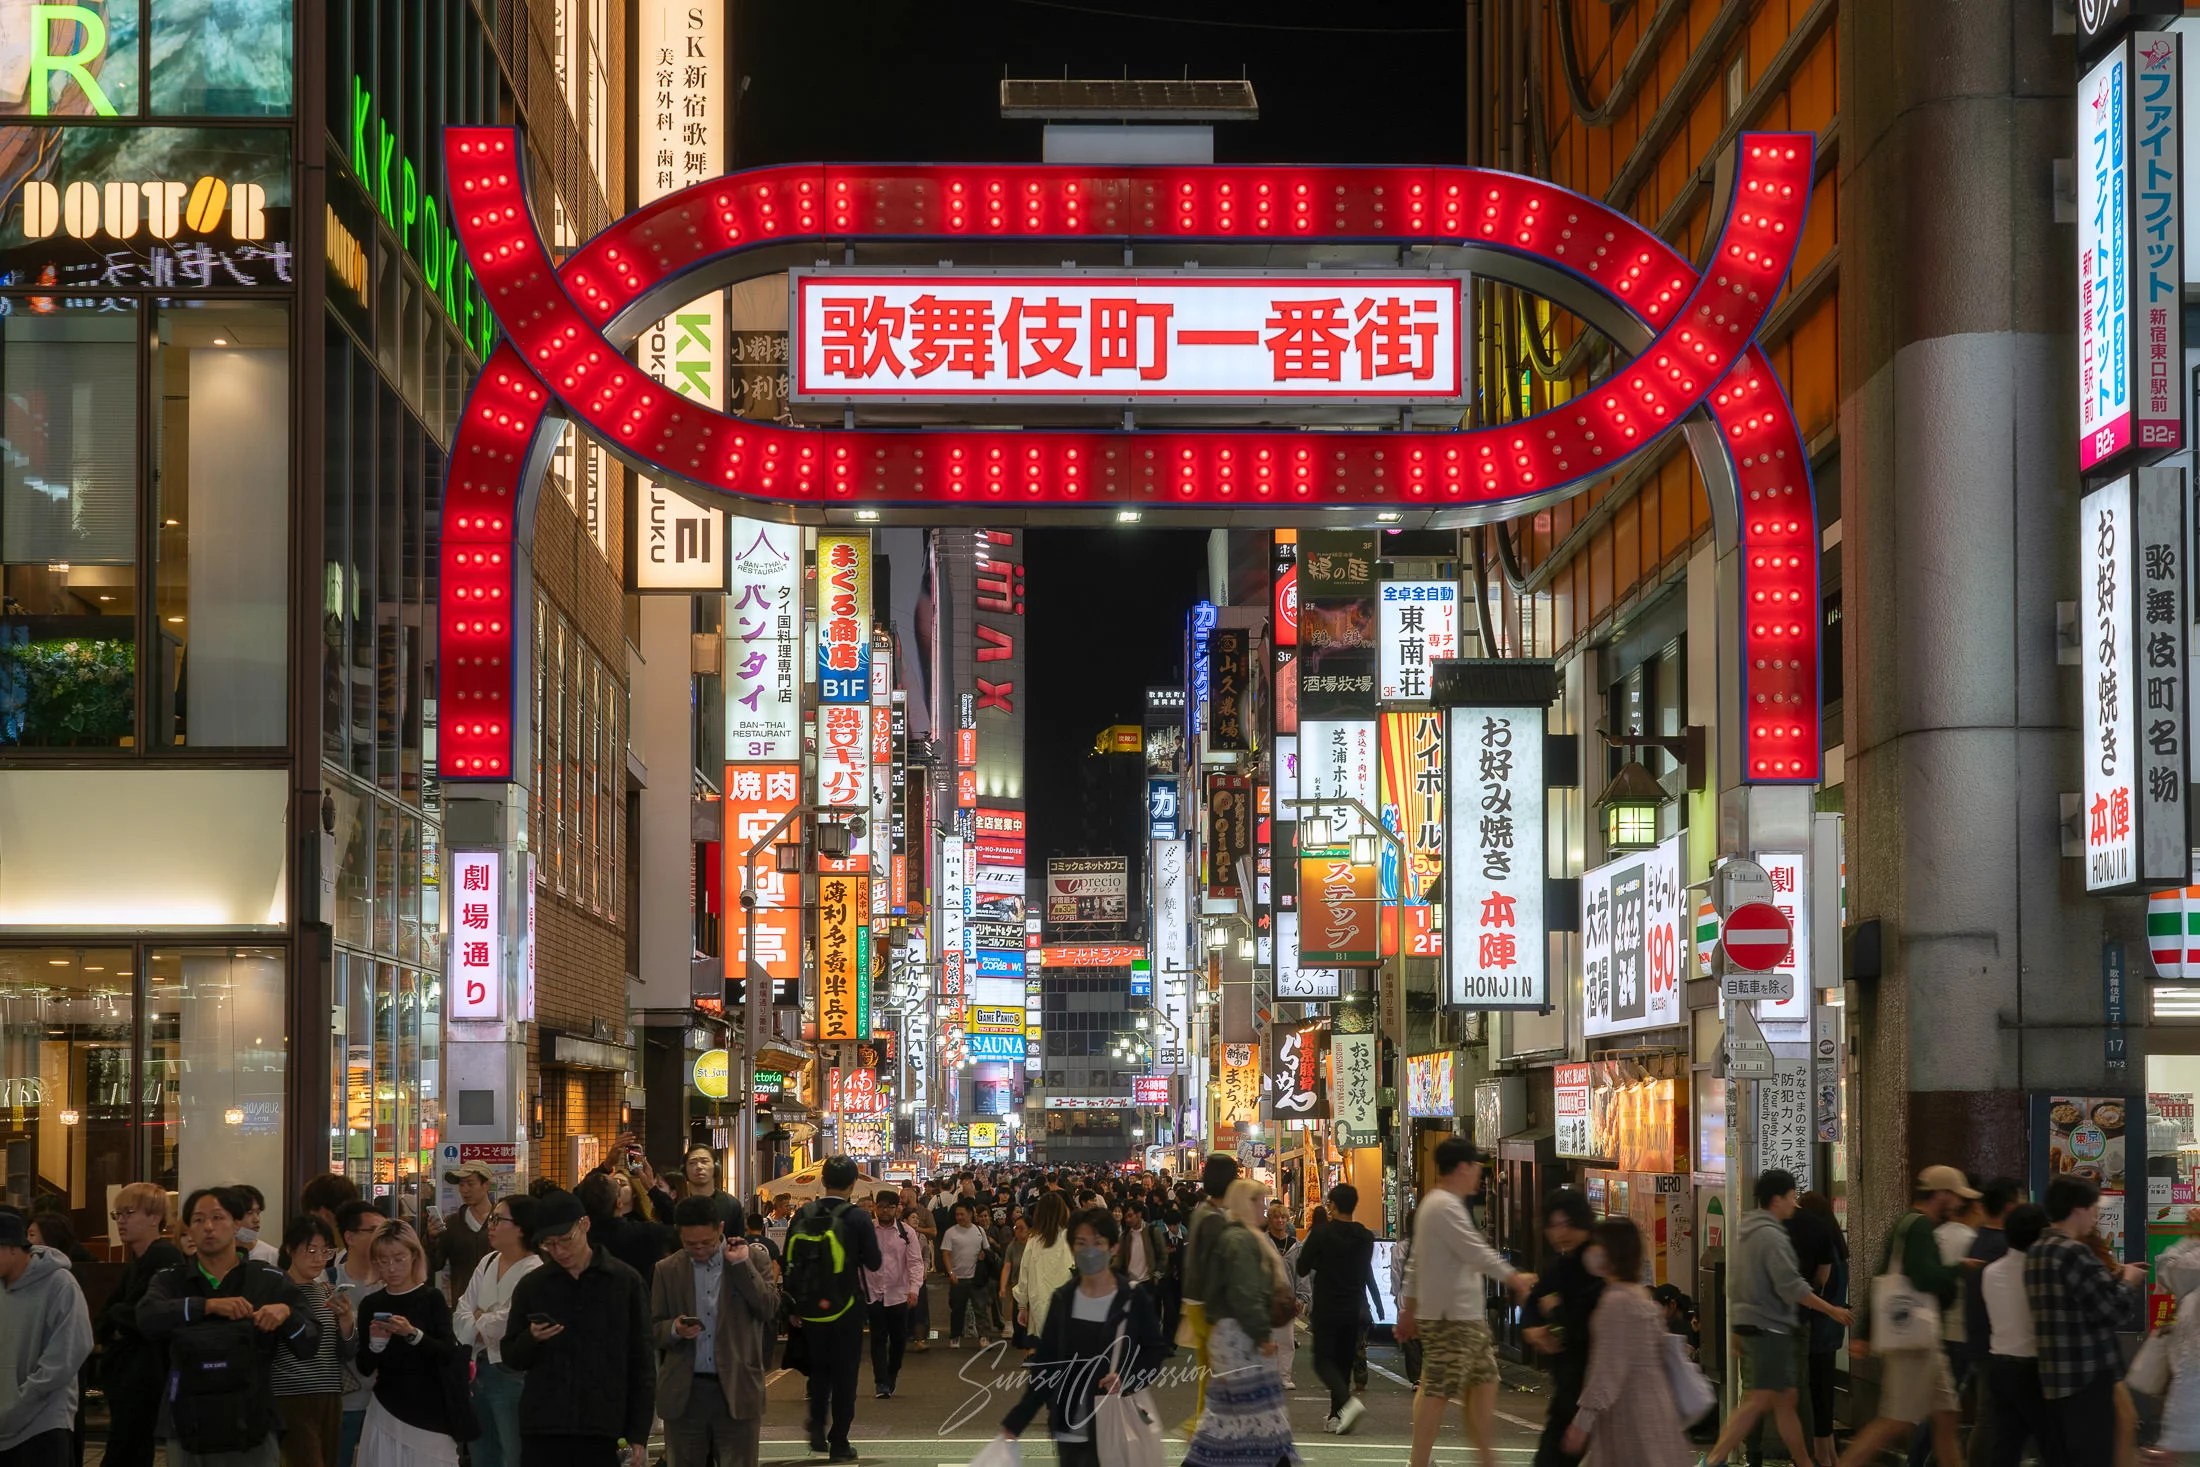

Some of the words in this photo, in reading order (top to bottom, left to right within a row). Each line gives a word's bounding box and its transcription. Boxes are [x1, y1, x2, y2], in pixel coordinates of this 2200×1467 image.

[682, 8, 707, 186] SK新宿歌舞
[656, 47, 674, 189] 美容外科・歯科
[2112, 67, 2122, 156] ボクシング
[2140, 73, 2175, 303] ファイトフィット
[23, 176, 266, 240] DOUTOR
[2113, 176, 2124, 308] キックボクシング
[2093, 127, 2110, 418] ファイトフィット
[822, 294, 1438, 381] 歌舞伎町一番街
[2082, 251, 2095, 425] 新宿東口駅前
[2113, 320, 2124, 402] ダイエット
[2148, 308, 2168, 413] 新宿東口駅前
[2095, 422, 2116, 459] B2F
[2143, 423, 2176, 444] B2F
[737, 563, 788, 576] RESTAURANT
[743, 560, 782, 569] BAN-THAI
[1277, 564, 1289, 573] 4F
[828, 543, 859, 671] まぐろ商店
[1383, 587, 1454, 602] 全卓全自動
[735, 584, 771, 712] バンタイ
[777, 585, 792, 703] タイ国料理専門店
[1277, 651, 1292, 662] 3F
[1398, 605, 1426, 698] 東南荘
[2097, 509, 2118, 778] お好み焼き
[1303, 675, 1374, 692] 酒場牧場
[2145, 543, 2179, 803] 歌舞伎町名物
[823, 680, 864, 697] B1F
[1383, 687, 1397, 697] 3F
[733, 730, 791, 738] RESTAURANT
[740, 721, 786, 729] BAN-THAI
[748, 742, 776, 756] 3F
[730, 771, 796, 801] 焼肉
[1415, 717, 1443, 849] ハイボール
[1478, 716, 1514, 881] お好み焼き
[975, 815, 1022, 832] 全店営業中
[2090, 785, 2130, 847] 本陣
[831, 859, 857, 871] 4F
[976, 872, 1023, 883] FACE
[1050, 861, 1125, 871] コミック&ネットカフェ
[2092, 846, 2128, 885] HONJIN
[1655, 863, 1676, 913] ビール
[1322, 862, 1361, 949] ステップ
[1586, 886, 1609, 949] 大衆
[461, 864, 490, 1005] 劇場通り
[1478, 891, 1518, 970] 本陣
[1335, 952, 1348, 961] B1
[1414, 935, 1443, 954] 2F
[1648, 922, 1674, 994] 190
[1073, 957, 1114, 965] ハンバーグ
[1317, 986, 1337, 996] B1F
[1464, 976, 1533, 998] HONJIN
[1586, 956, 1609, 1019] 酒場
[1727, 980, 1789, 995] 自転車を除く
[977, 1010, 994, 1022] GAME
[996, 1010, 1013, 1023] PANIC
[973, 1036, 1025, 1054] SAUNA
[1226, 1048, 1249, 1061] 新宿
[2108, 1039, 2124, 1052] 17
[1137, 1080, 1168, 1090] 24時間
[1225, 1068, 1243, 1121] まっちゃん
[1347, 1041, 1374, 1122] お好み焼き
[1055, 1099, 1085, 1107] コーヒー
[1105, 1098, 1128, 1107] クール
[1137, 1091, 1168, 1102] 営業中
[1761, 1087, 1771, 1121] Security
[1771, 1090, 1780, 1108] Your
[1770, 1111, 1780, 1138] Safety
[1356, 1134, 1377, 1145] B1F
[1761, 1123, 1771, 1156] Camera
[1761, 1158, 1769, 1166] in
[1656, 1176, 1681, 1193] NERO
[2173, 1190, 2192, 1200] SIM
